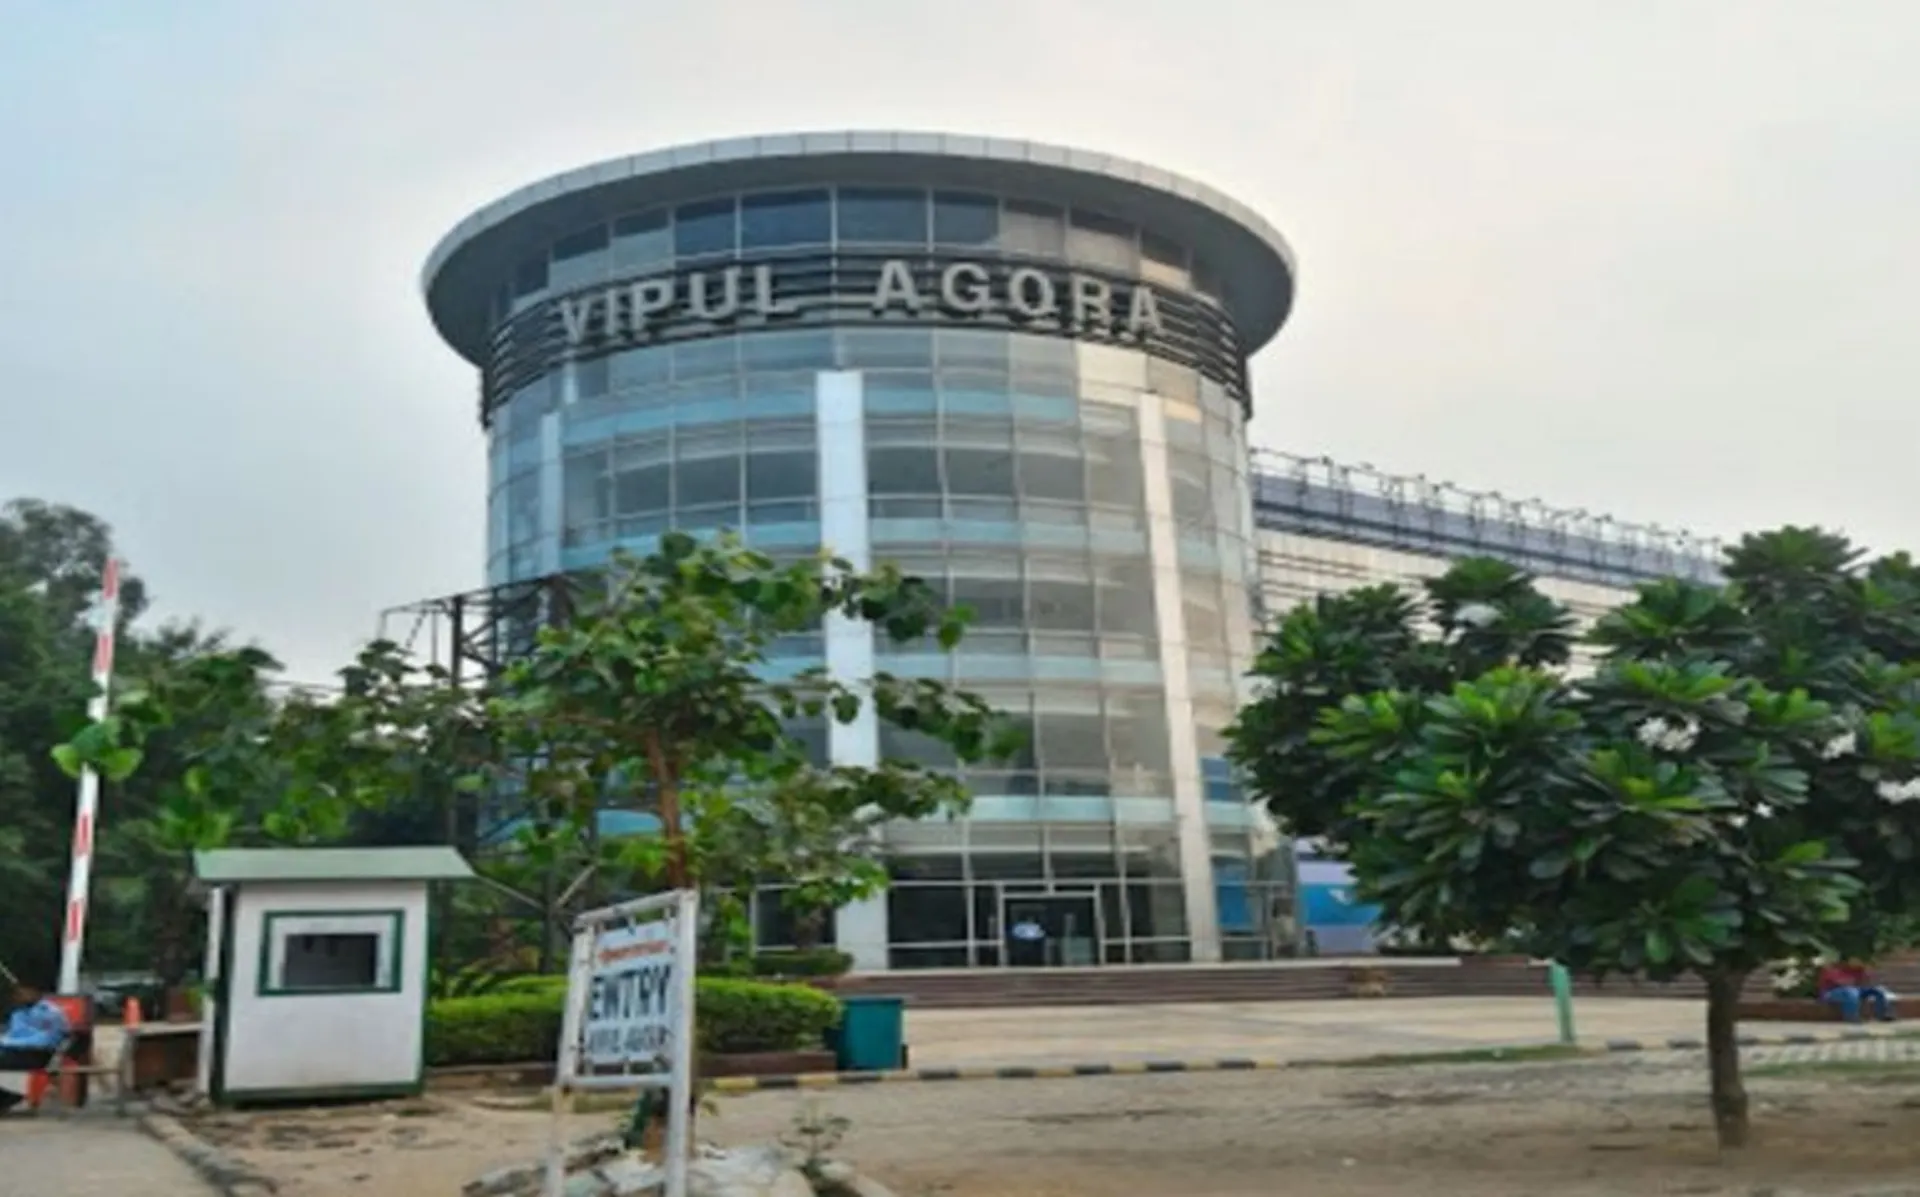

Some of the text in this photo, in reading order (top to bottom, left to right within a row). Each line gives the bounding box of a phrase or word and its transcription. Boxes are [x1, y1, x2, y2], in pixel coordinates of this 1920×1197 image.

[559, 259, 1166, 345] VIPUL AGORA
[588, 964, 672, 1020] ENTRY
